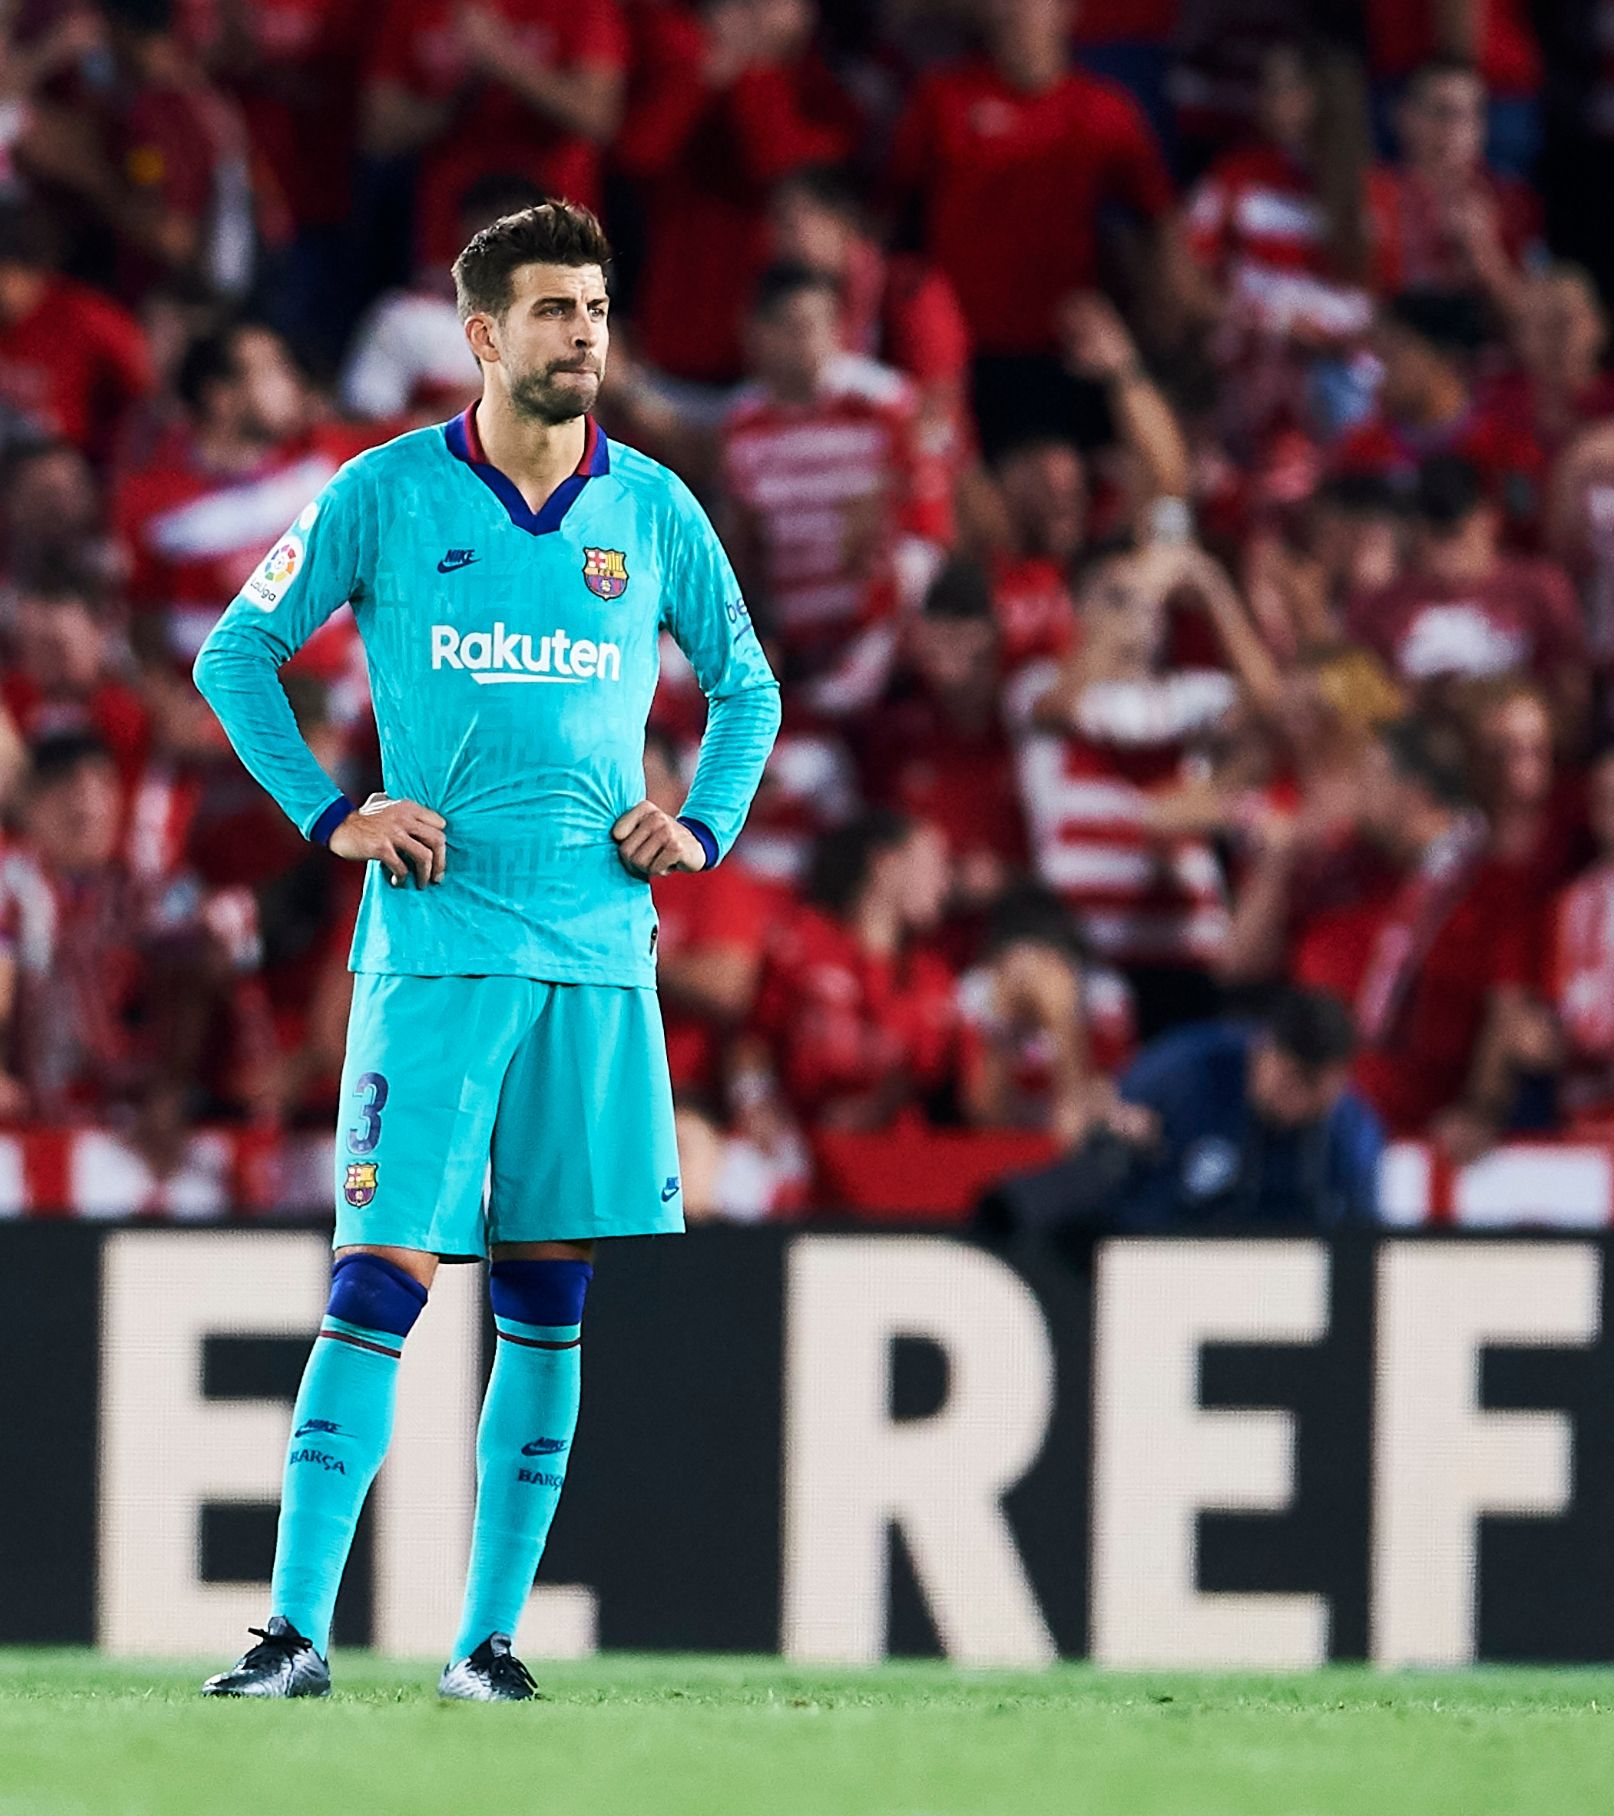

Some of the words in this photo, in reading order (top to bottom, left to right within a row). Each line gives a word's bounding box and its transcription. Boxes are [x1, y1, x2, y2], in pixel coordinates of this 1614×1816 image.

[431, 621, 621, 682] Rakuten
[346, 1071, 389, 1155] 3
[98, 1230, 597, 1657] EL
